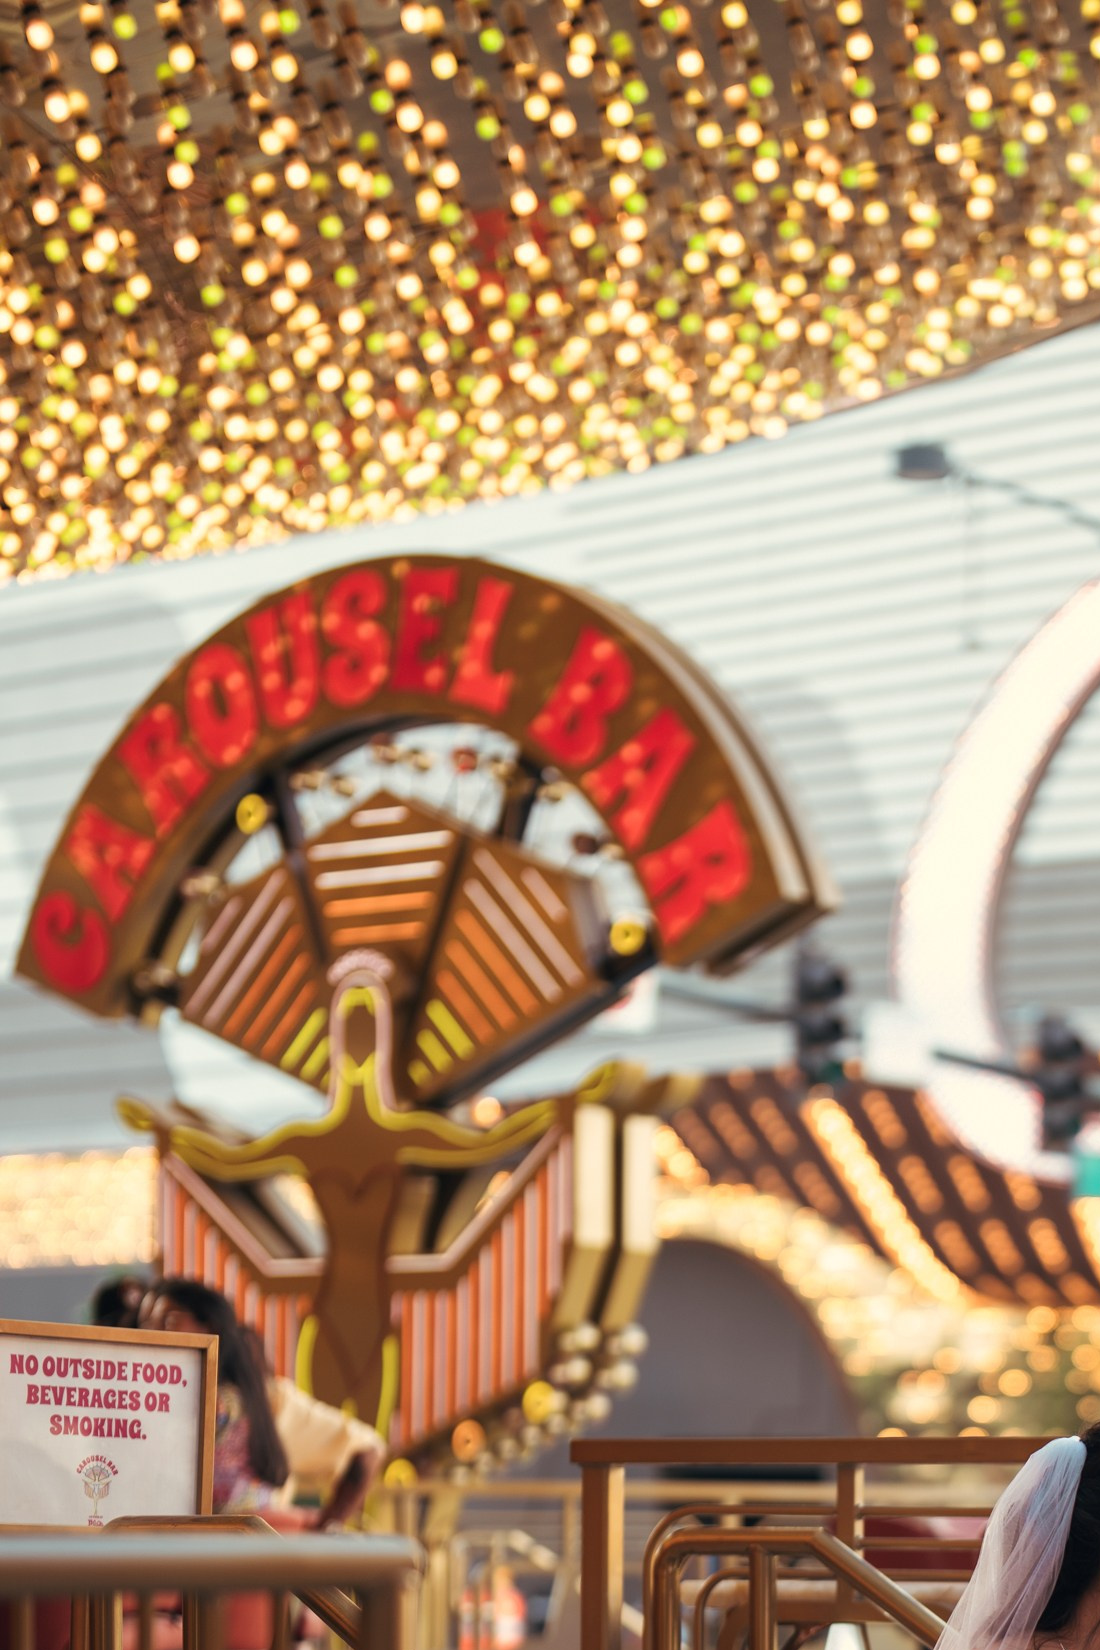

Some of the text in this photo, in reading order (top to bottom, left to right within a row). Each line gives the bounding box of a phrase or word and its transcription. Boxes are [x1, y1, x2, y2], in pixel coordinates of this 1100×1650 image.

[30, 566, 752, 995] CAROUSEL BAR
[10, 1354, 187, 1387] NO OUTSIDE FOOD,
[26, 1384, 170, 1413] BEVERAGES OR
[50, 1414, 147, 1440] SMOKING.
[76, 1455, 107, 1474] CAROUSEL
